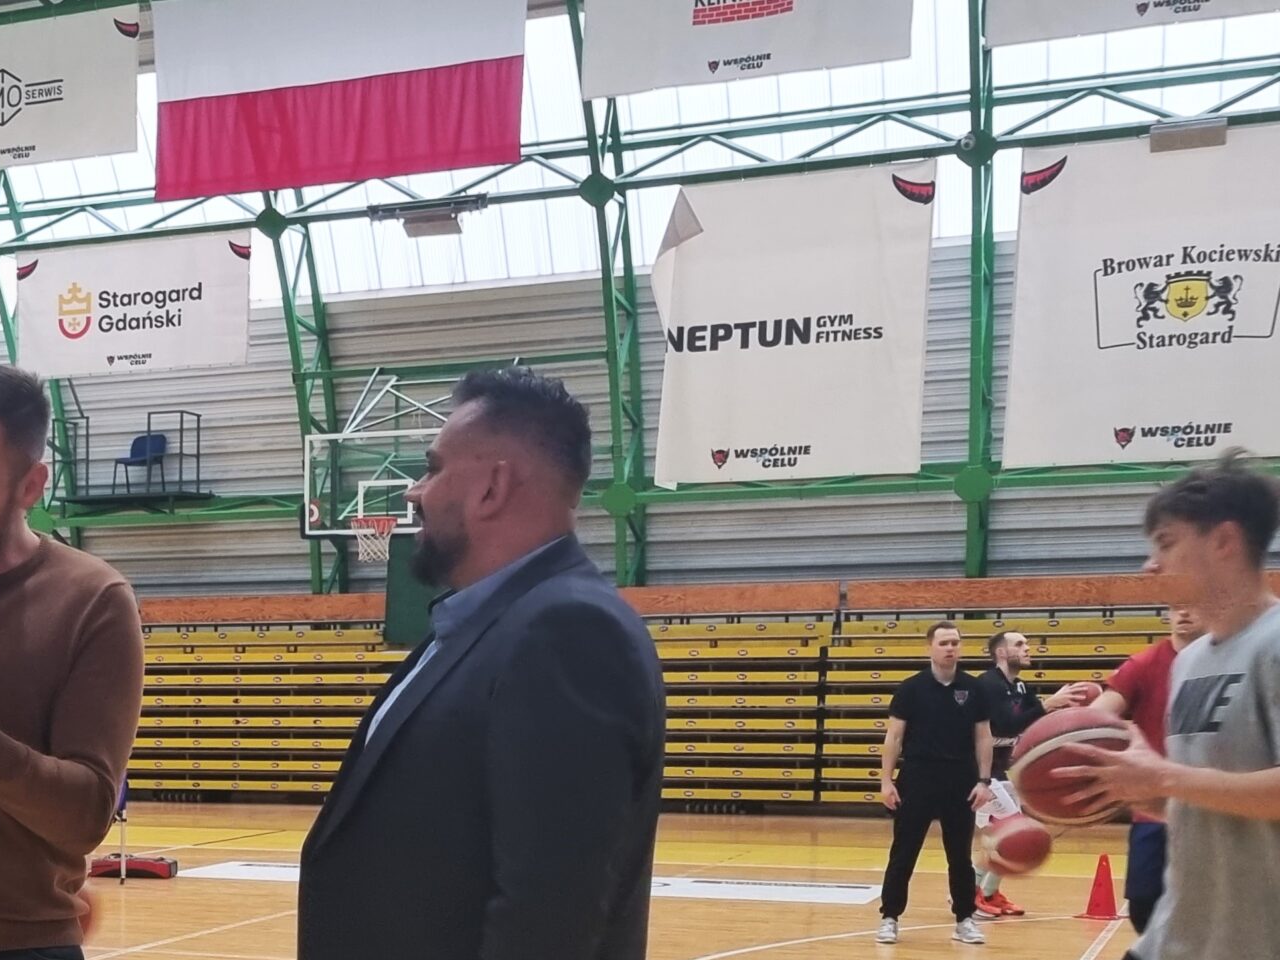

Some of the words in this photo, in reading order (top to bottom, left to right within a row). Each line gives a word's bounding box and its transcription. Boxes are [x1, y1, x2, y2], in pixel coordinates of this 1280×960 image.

[1173, 4, 1201, 14] CELU
[740, 61, 764, 71] CELU
[24, 85, 63, 100] SERWIS
[1101, 252, 1175, 277] Browar
[1181, 243, 1280, 265] Kociewski
[98, 281, 203, 309] Starogard
[98, 308, 182, 333] Gdański
[816, 313, 854, 329] GYM
[667, 316, 812, 353] NEPTUN
[815, 326, 884, 344] FITNESS
[1136, 325, 1234, 350] Starogard
[1140, 422, 1233, 437] WSPÓLNIE
[1174, 436, 1217, 448] CELU
[733, 444, 812, 459] WSPÓLNIE
[761, 457, 798, 468] CELU
